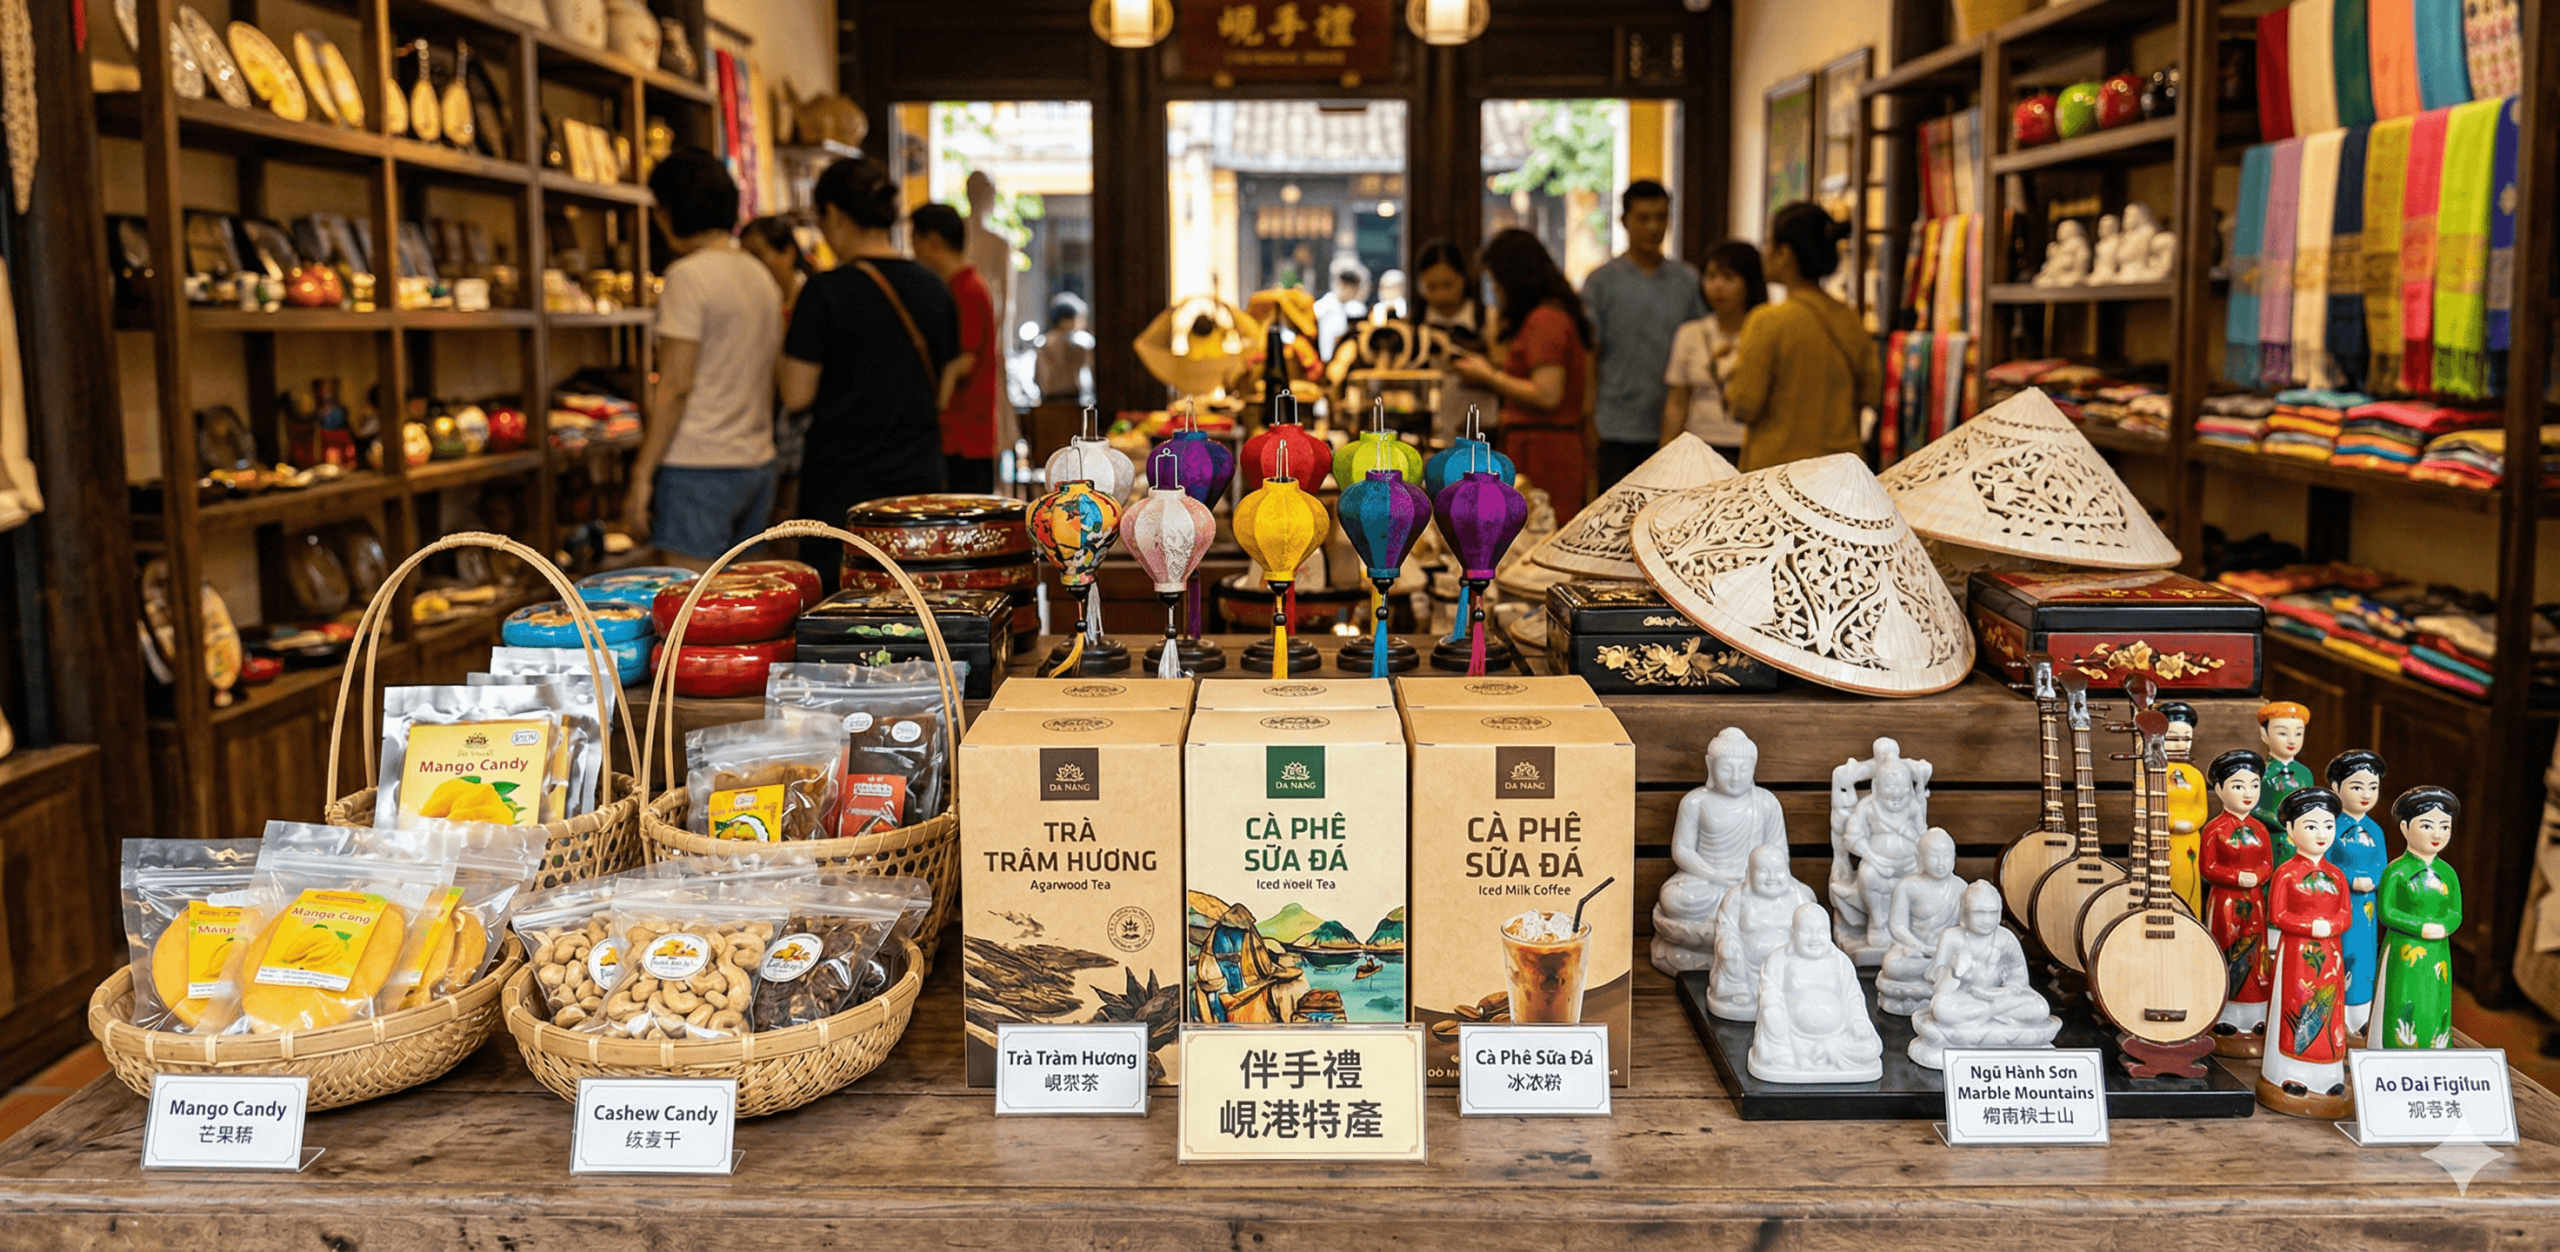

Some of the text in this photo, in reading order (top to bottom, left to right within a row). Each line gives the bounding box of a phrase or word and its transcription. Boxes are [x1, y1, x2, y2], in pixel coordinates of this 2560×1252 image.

[419, 757, 529, 775] Mango Candy
[1049, 783, 1091, 792] DA NANG
[1275, 781, 1317, 790] DA NANG
[1504, 782, 1546, 790] DA NANG
[1043, 816, 1097, 843] TRÀ
[1246, 811, 1346, 840] CÀ PHÊ
[1467, 810, 1581, 843] CÀ PHÊ
[984, 847, 1157, 872] TRÂM HƯƠNG
[1244, 843, 1349, 872] SỮA ĐÁ
[1465, 845, 1584, 878] SỮA ĐÁ
[1030, 879, 1111, 893] Agarwood Tea
[1256, 878, 1280, 889] Iced
[1316, 878, 1336, 890] Tea
[1478, 883, 1571, 895] Iced Milk Coffee
[1007, 1049, 1137, 1069] Trà Tràm Hương
[1475, 1049, 1496, 1065] Cà
[1500, 1049, 1532, 1065] Phê
[1536, 1048, 1567, 1065] Sữa
[1570, 1049, 1594, 1065] Đá
[1239, 1049, 1363, 1090] 伴手禮
[2005, 1064, 2045, 1079] Hành
[2048, 1065, 2078, 1079] Sơn
[1958, 1085, 2095, 1100] Marble Mountains
[2375, 1076, 2397, 1092] Ao
[2401, 1076, 2430, 1092] Đai
[169, 1099, 288, 1121] Mango Candy
[594, 1104, 719, 1126] Cashew Candy
[1220, 1098, 1384, 1139] 峴港特產
